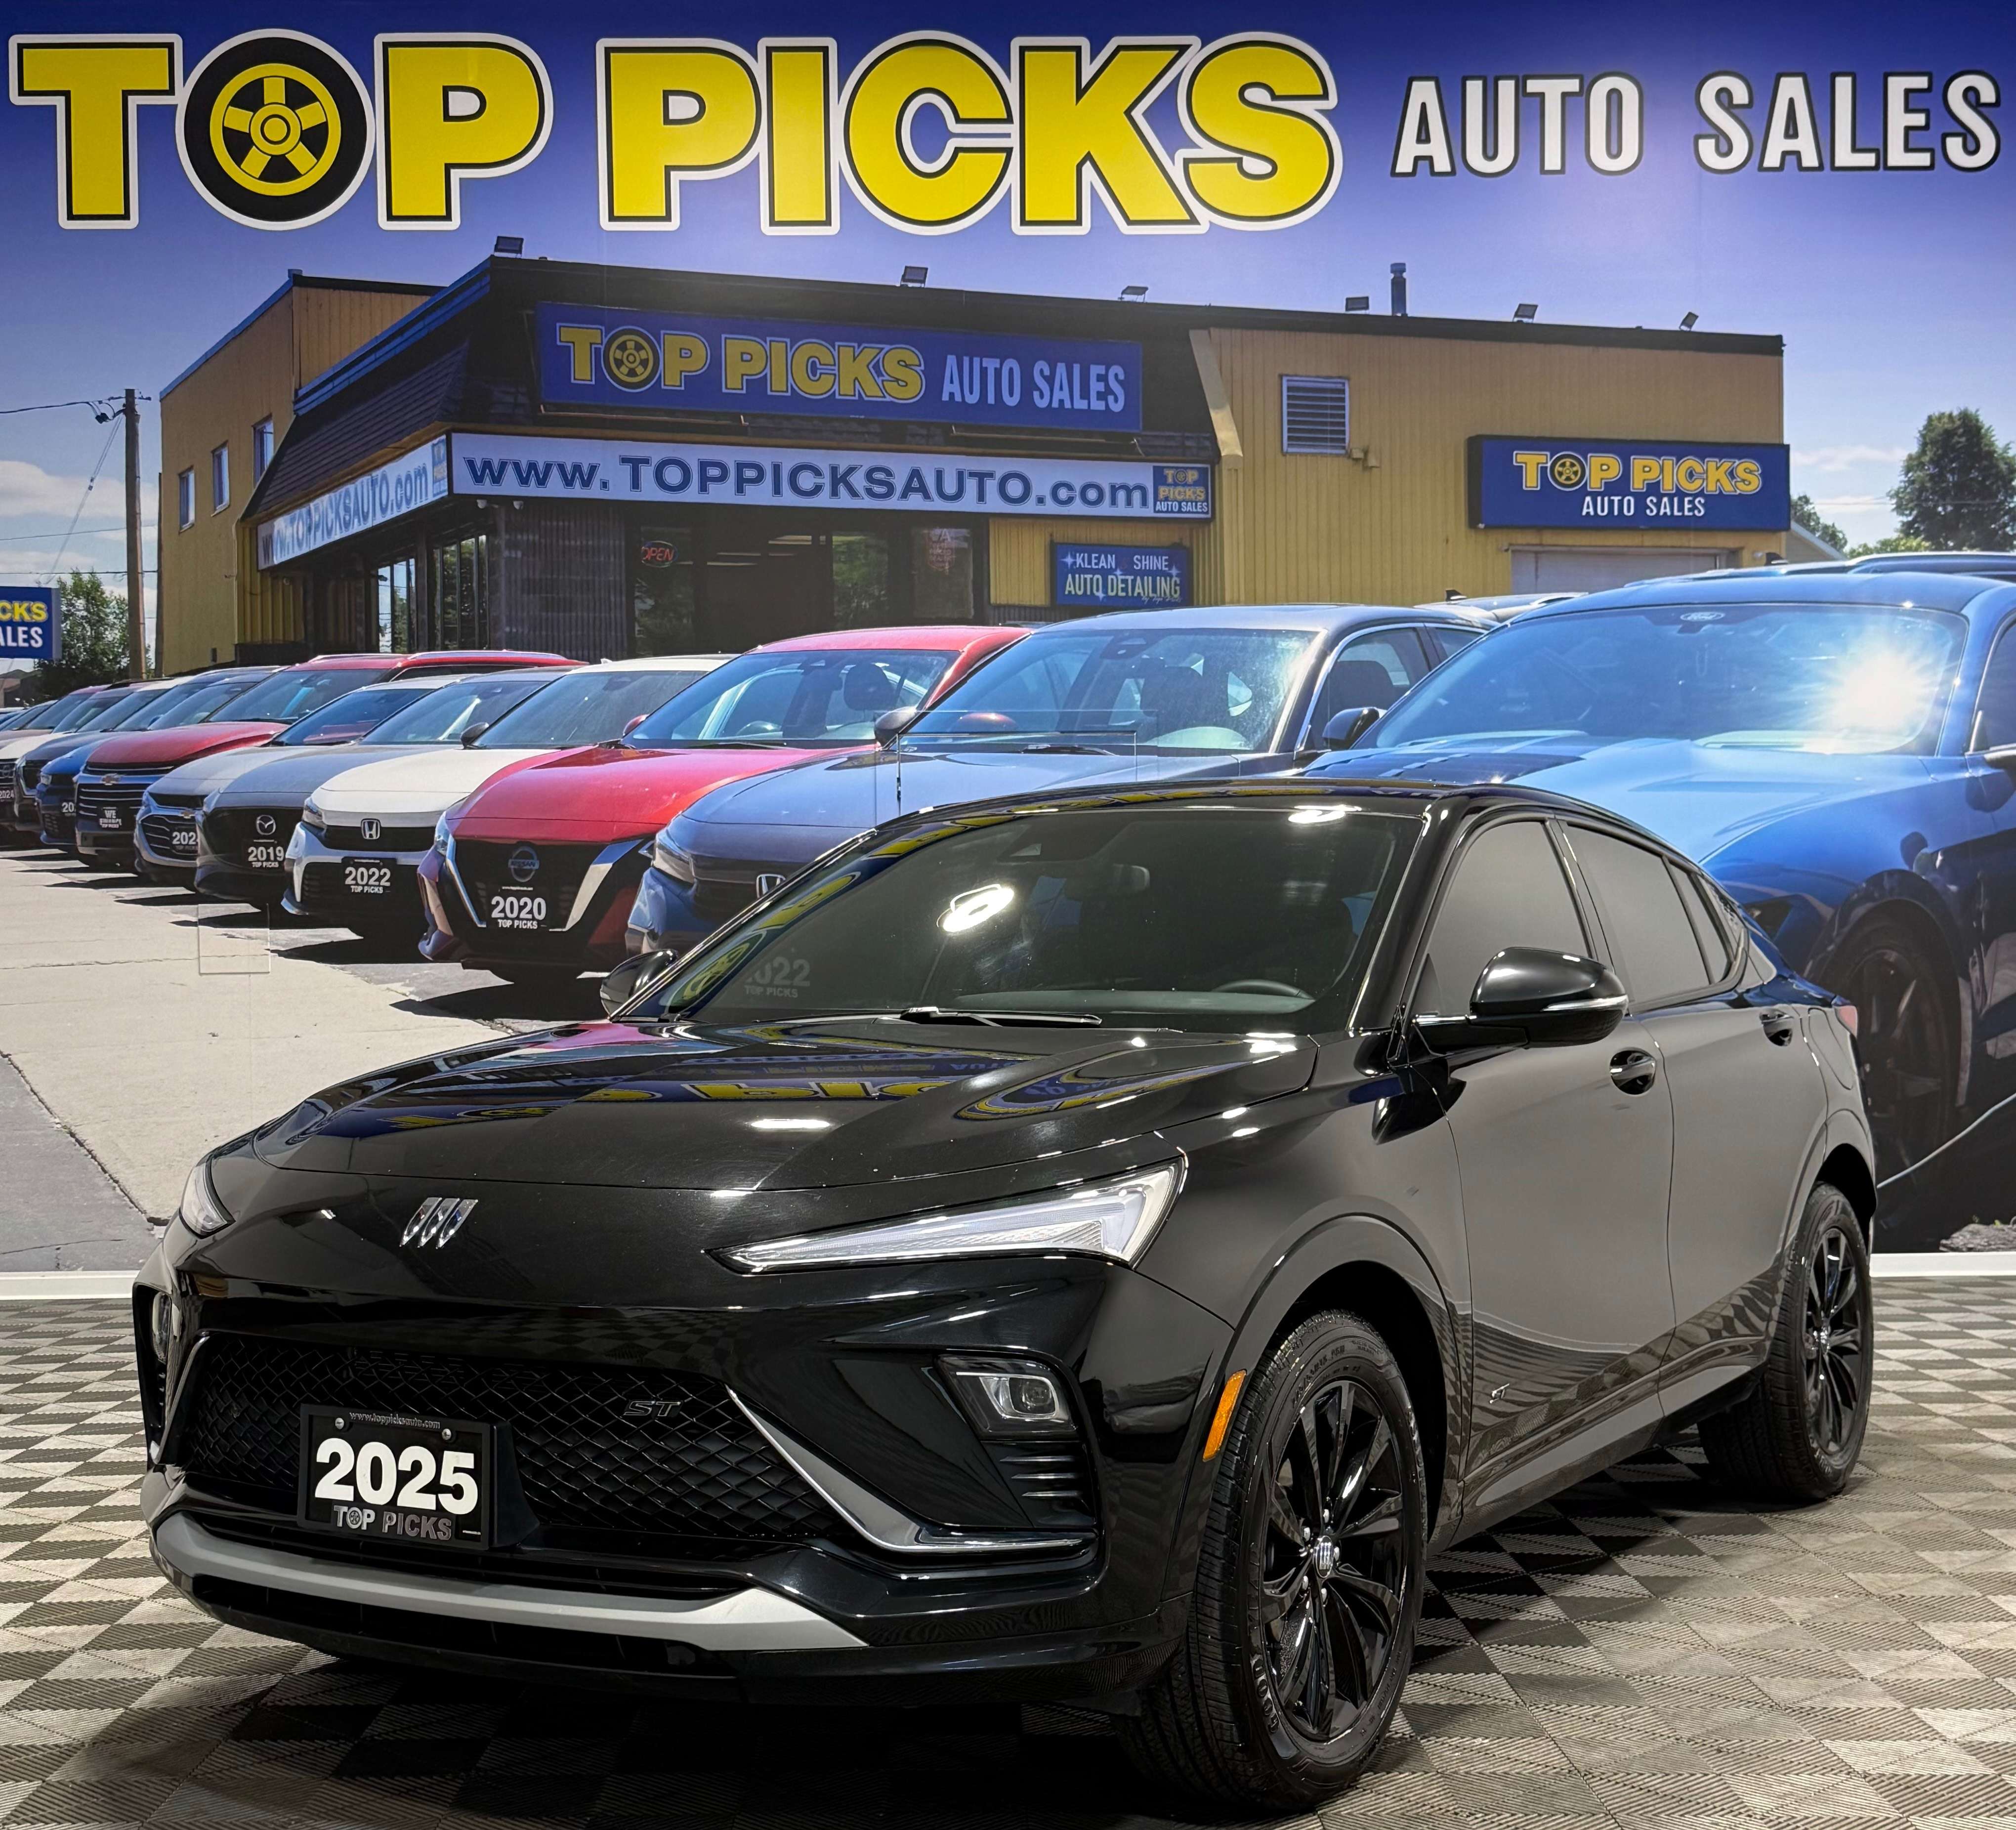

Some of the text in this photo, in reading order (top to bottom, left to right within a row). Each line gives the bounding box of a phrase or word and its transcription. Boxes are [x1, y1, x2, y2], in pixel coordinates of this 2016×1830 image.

[8, 28, 2001, 235] TOP PICKS AUTO SALES
[556, 323, 1125, 413] TOP PICKS AUTO SALES
[1164, 468, 1199, 484] TOP
[1513, 451, 1762, 495] TOP PICKS
[1158, 485, 1206, 501] PICKS
[1156, 501, 1208, 512] AUTO SALES
[1582, 496, 1705, 516] AUTO SALES
[641, 546, 674, 561] OPEN
[1076, 553, 1115, 569] KLEAN
[1134, 555, 1169, 571] SHINE
[1065, 574, 1180, 598] AUTO DETAILING
[172, 832, 198, 845] 202
[248, 846, 284, 861] 2019
[345, 867, 391, 886] 2022
[491, 896, 546, 920] 2020
[498, 919, 538, 929] TOP PICKS
[766, 987, 798, 998] PICKS
[623, 1400, 681, 1416] ST
[349, 1412, 441, 1429] www.toppicksauto.com
[315, 1438, 478, 1515] 2025
[334, 1505, 452, 1540] TOP PICKS
